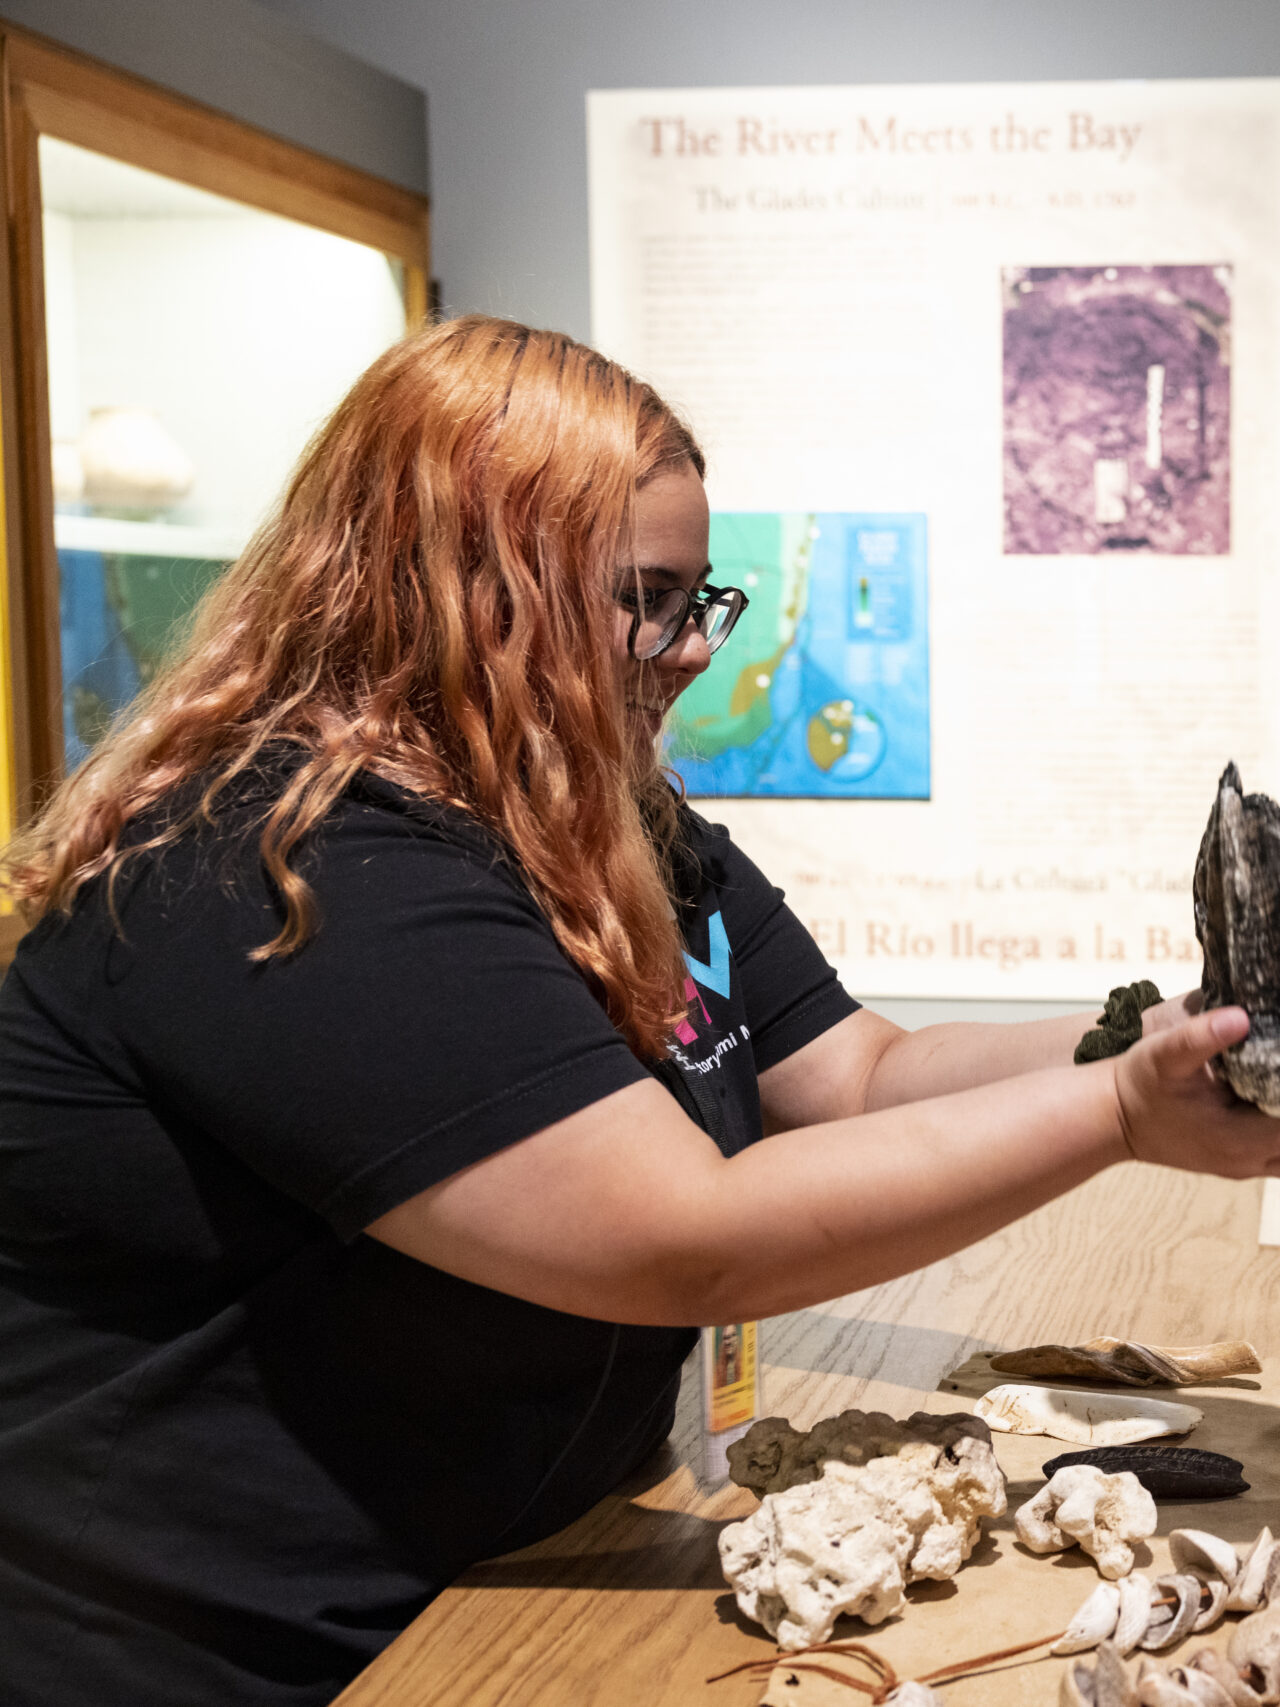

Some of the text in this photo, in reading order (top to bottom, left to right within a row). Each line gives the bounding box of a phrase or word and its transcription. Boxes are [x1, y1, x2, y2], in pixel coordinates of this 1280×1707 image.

[639, 111, 1143, 162] The River Meets the Bay
[694, 185, 738, 214] The
[809, 917, 1204, 972] El Río llega a la Ba
